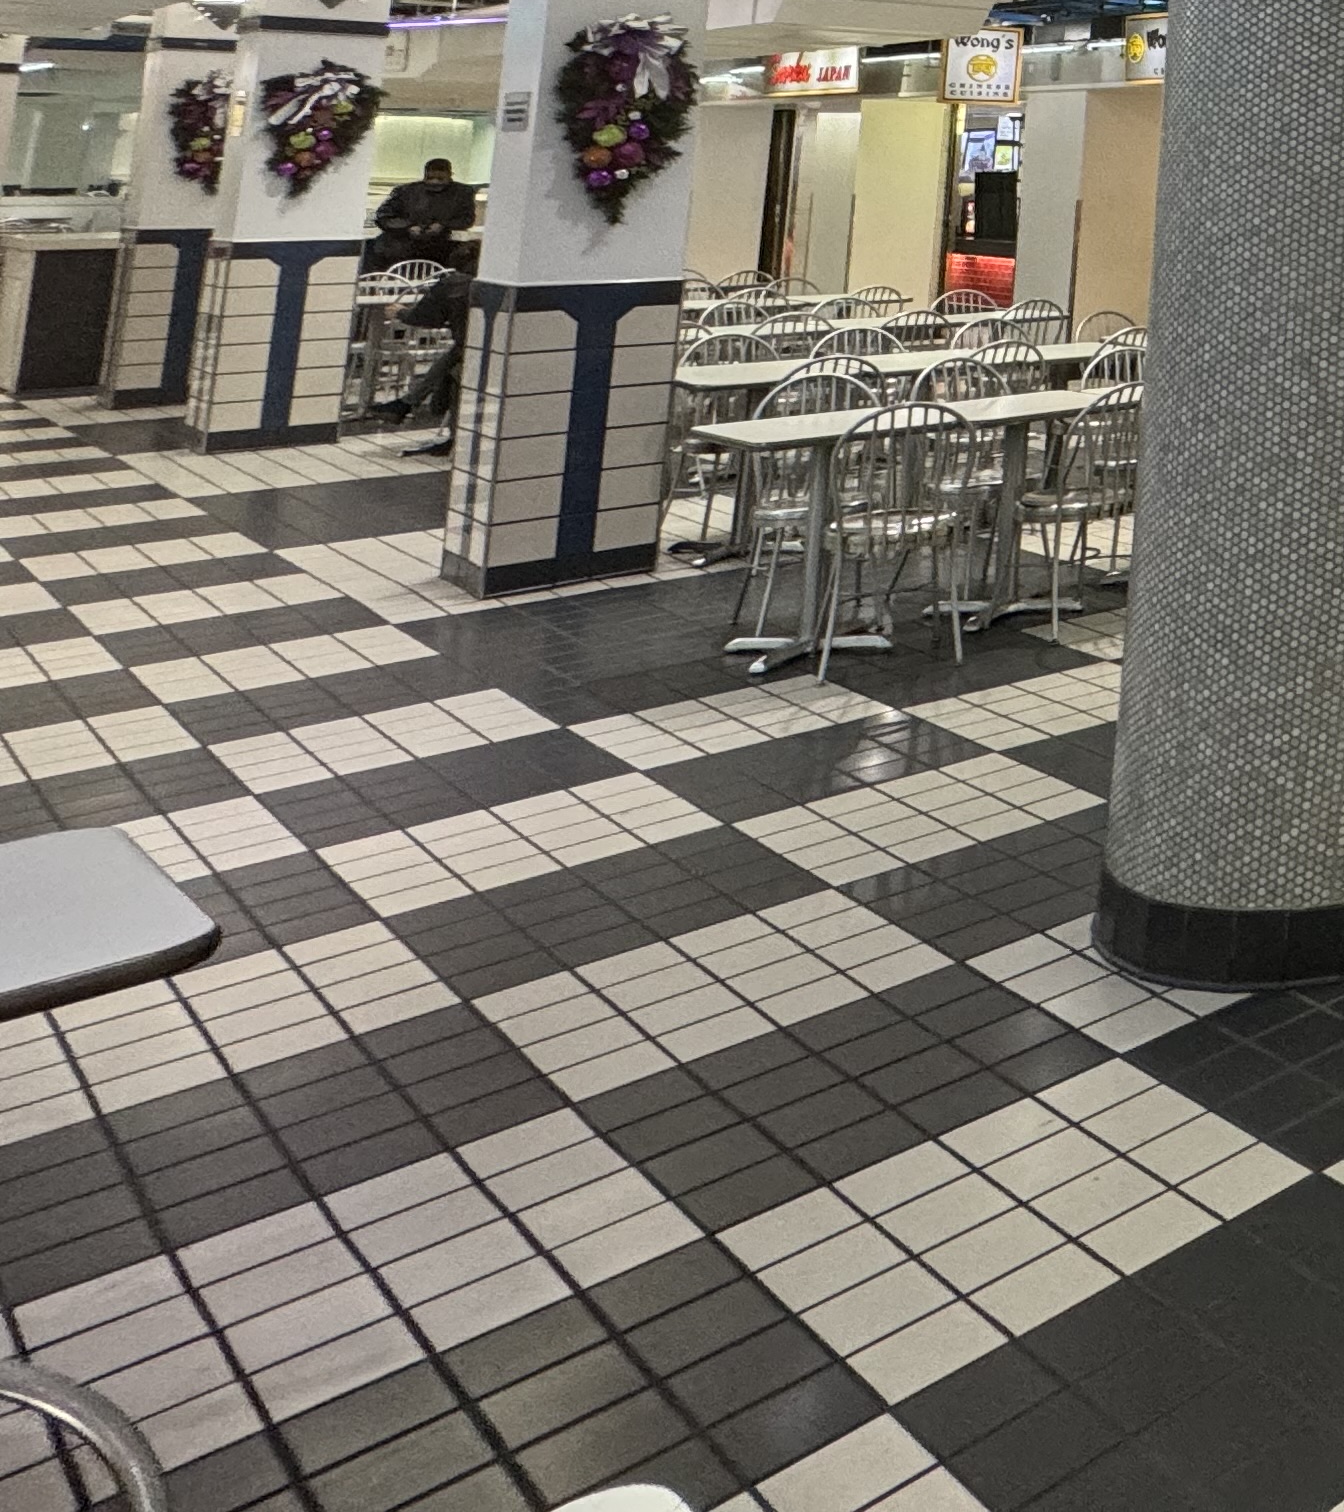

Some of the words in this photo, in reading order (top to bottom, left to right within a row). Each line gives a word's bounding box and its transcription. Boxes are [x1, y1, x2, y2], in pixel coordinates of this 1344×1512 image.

[954, 34, 1014, 53] Wong's
[816, 65, 852, 82] JAPAN
[949, 82, 1010, 90] CHINESE
